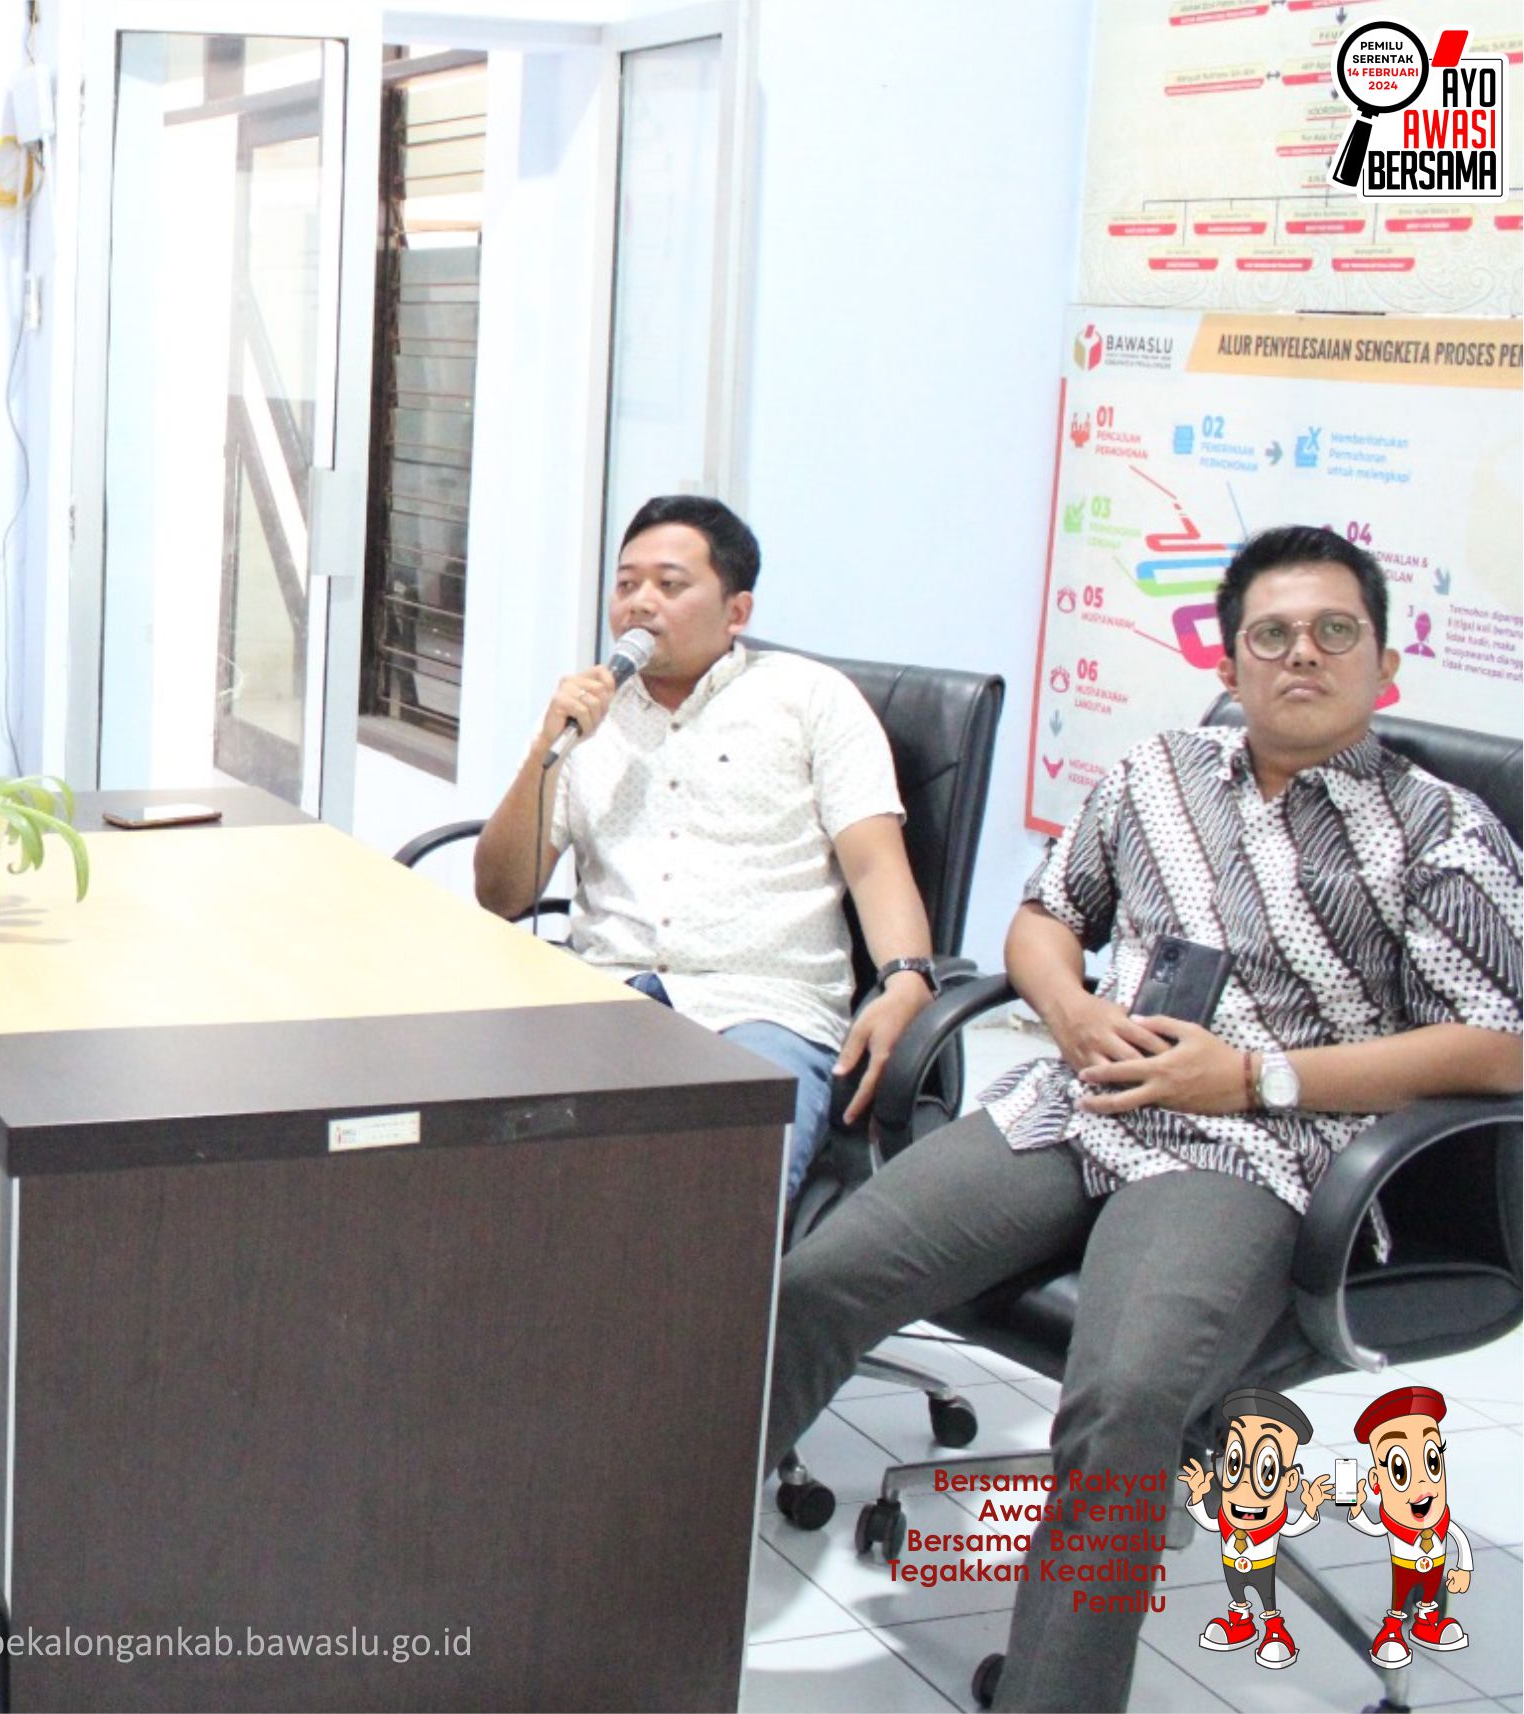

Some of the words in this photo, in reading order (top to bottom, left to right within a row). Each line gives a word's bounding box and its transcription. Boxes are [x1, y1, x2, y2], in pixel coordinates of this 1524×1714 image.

[1106, 334, 1173, 354] BAWASLU
[1218, 333, 1252, 356] ALUR
[1255, 335, 1352, 361] PENYELESAIAN
[1355, 339, 1430, 364] SENGKETA
[1435, 342, 1494, 367] PROSES
[1096, 406, 1114, 428] 01
[1202, 415, 1225, 438] 02
[1091, 495, 1112, 519] 03
[1346, 521, 1372, 545] 04
[1083, 585, 1104, 608] 05
[1077, 658, 1098, 682] 06
